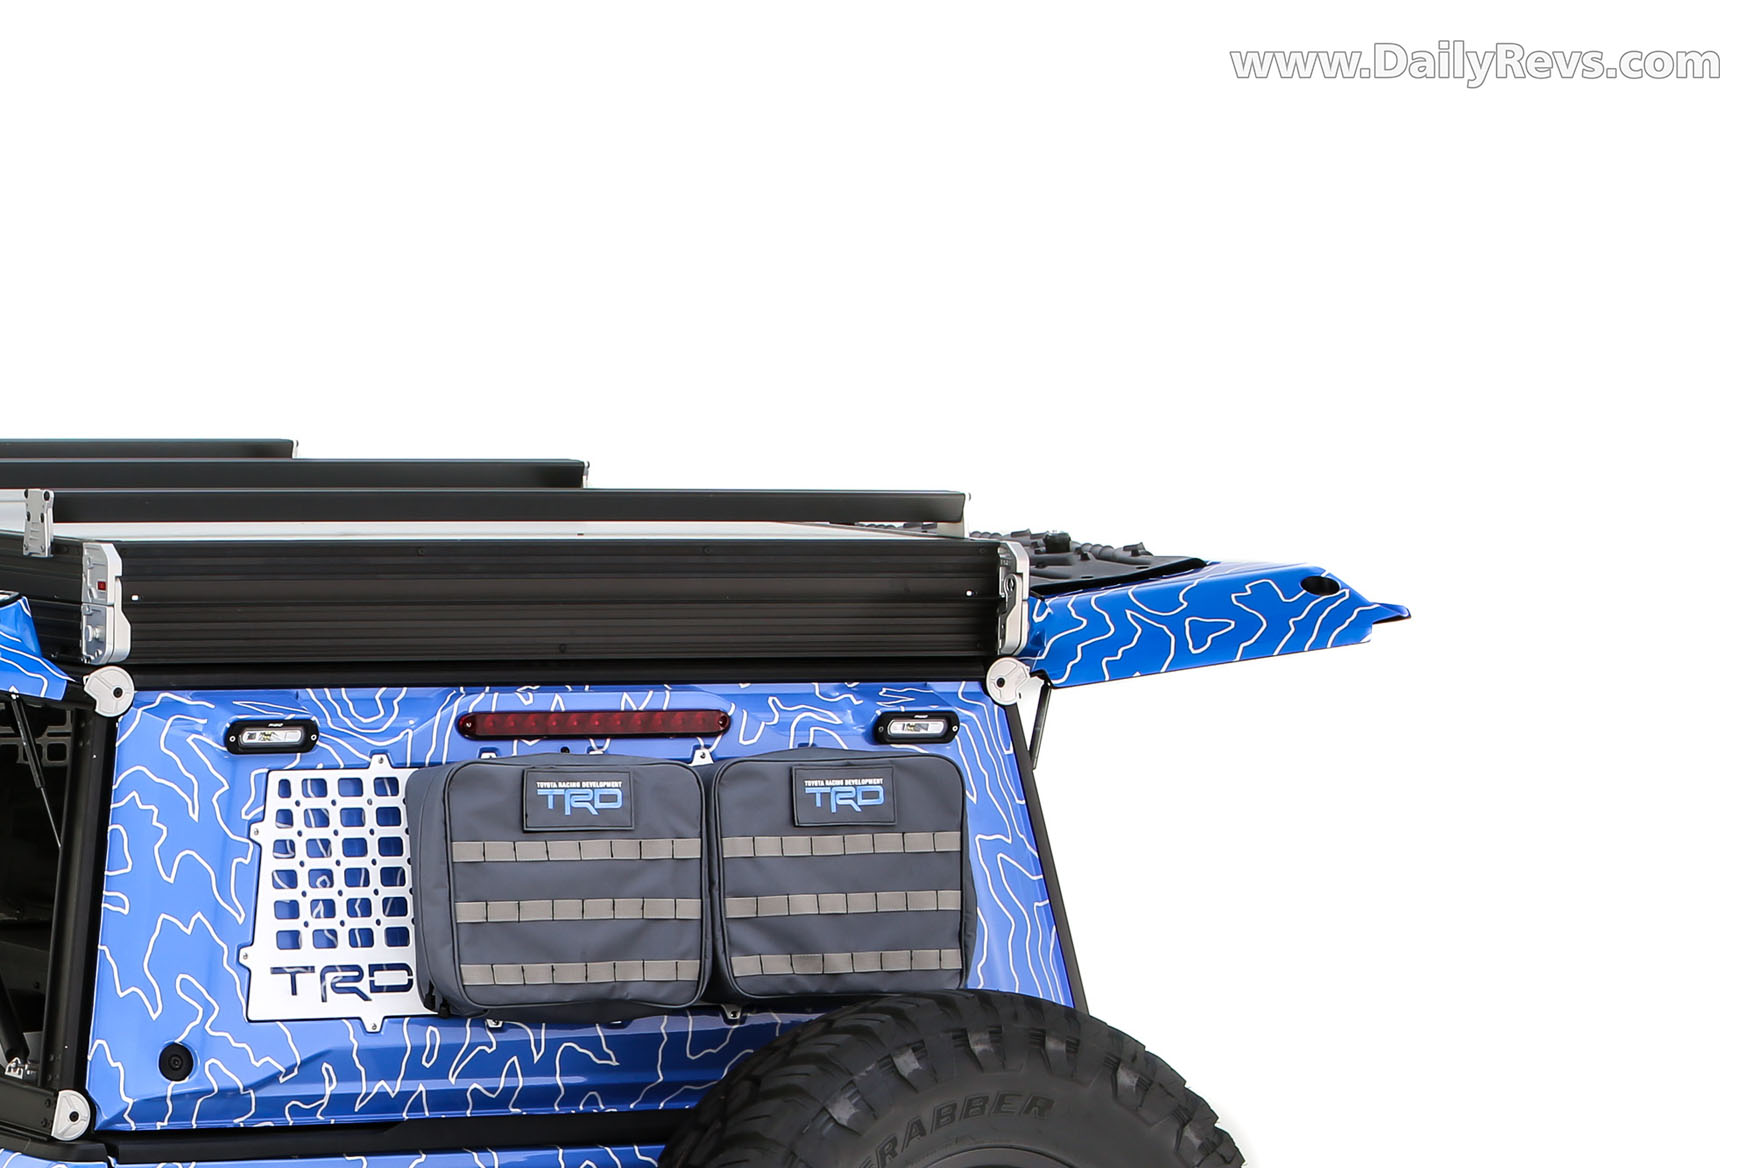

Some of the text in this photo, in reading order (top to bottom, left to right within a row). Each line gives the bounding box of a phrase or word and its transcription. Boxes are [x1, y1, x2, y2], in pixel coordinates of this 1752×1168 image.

[536, 788, 623, 816] TRD
[804, 785, 885, 814] TRD
[270, 962, 414, 1003] TRD
